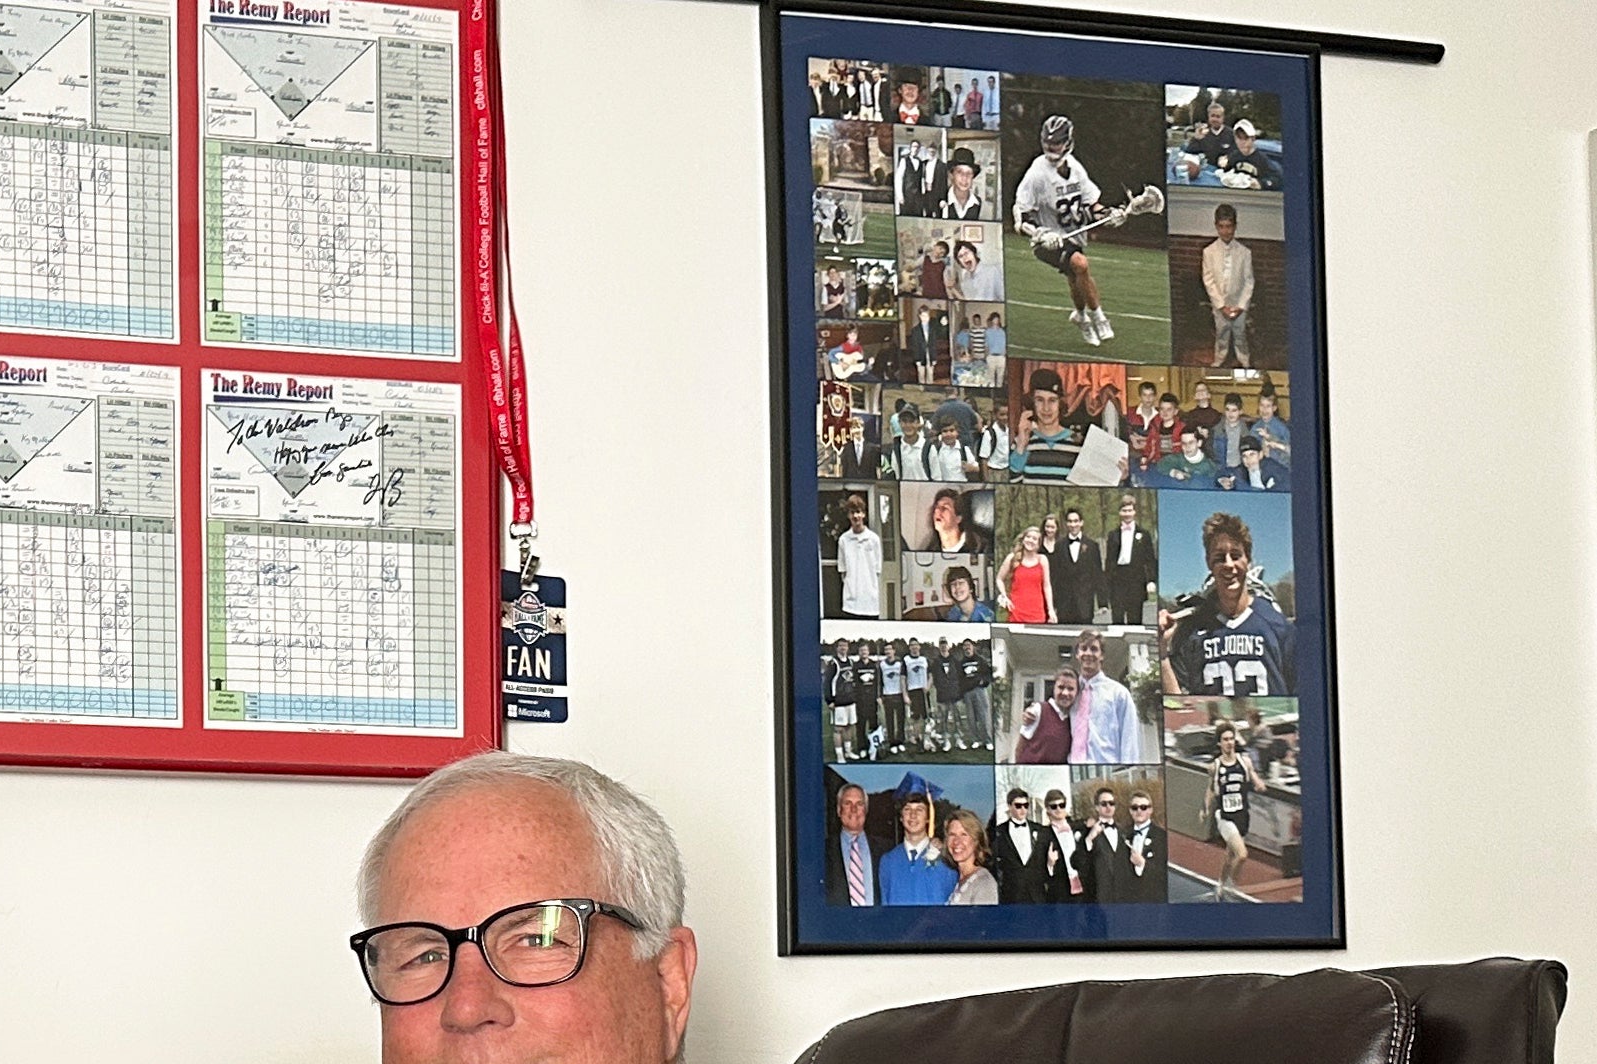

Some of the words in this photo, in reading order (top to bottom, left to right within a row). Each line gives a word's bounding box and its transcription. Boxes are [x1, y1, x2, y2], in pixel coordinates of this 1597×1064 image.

[283, 1, 330, 24] Report
[477, 117, 487, 147] Fame
[479, 149, 488, 159] of
[477, 161, 489, 184] Hall
[478, 185, 490, 226] Football
[478, 228, 490, 269] College
[210, 373, 239, 393] The
[242, 374, 283, 399] Remy
[287, 378, 334, 400] Report
[497, 413, 509, 447] Fame
[507, 645, 551, 680] FAN
[518, 707, 551, 718] Microsoft
